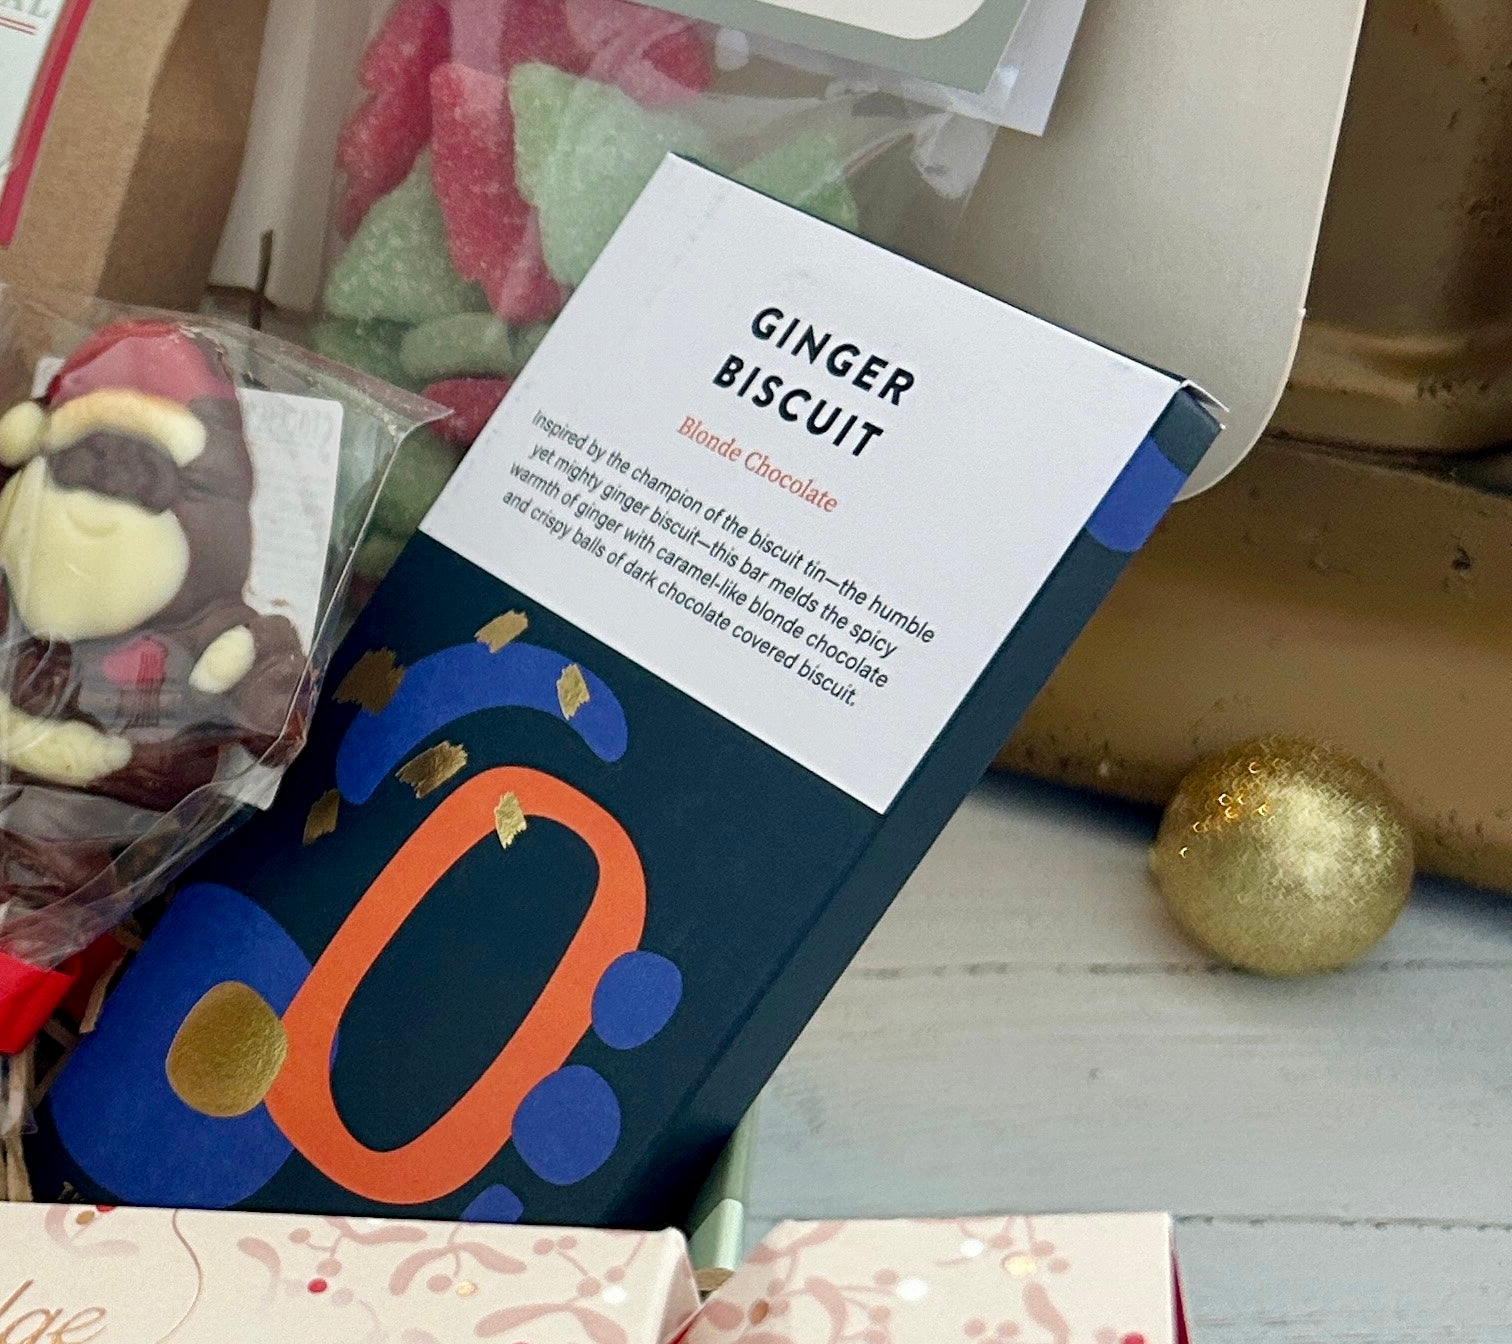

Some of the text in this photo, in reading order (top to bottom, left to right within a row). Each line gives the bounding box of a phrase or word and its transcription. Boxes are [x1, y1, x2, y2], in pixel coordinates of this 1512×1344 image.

[677, 414, 839, 514] Blonde Chocolate
[712, 354, 883, 457] BISCUIT
[751, 306, 915, 406] GINGER
[503, 490, 857, 707] and crispy balls of dark chocolate covered biscuit.
[509, 460, 889, 688] warmth of ginger with caramel-like blonde chocolate
[528, 443, 556, 465] yet
[553, 456, 604, 493] mighty
[600, 484, 651, 517] ginger
[739, 556, 770, 583] bar
[767, 575, 819, 613] melds
[819, 602, 849, 629] the
[849, 622, 898, 659] spicy
[531, 409, 589, 450] Inspired
[587, 438, 607, 463] by
[606, 450, 631, 475] the
[631, 466, 703, 514] champion
[703, 508, 726, 524] of
[722, 513, 749, 539] the
[748, 527, 804, 570] biscuit
[868, 594, 936, 643] humble
